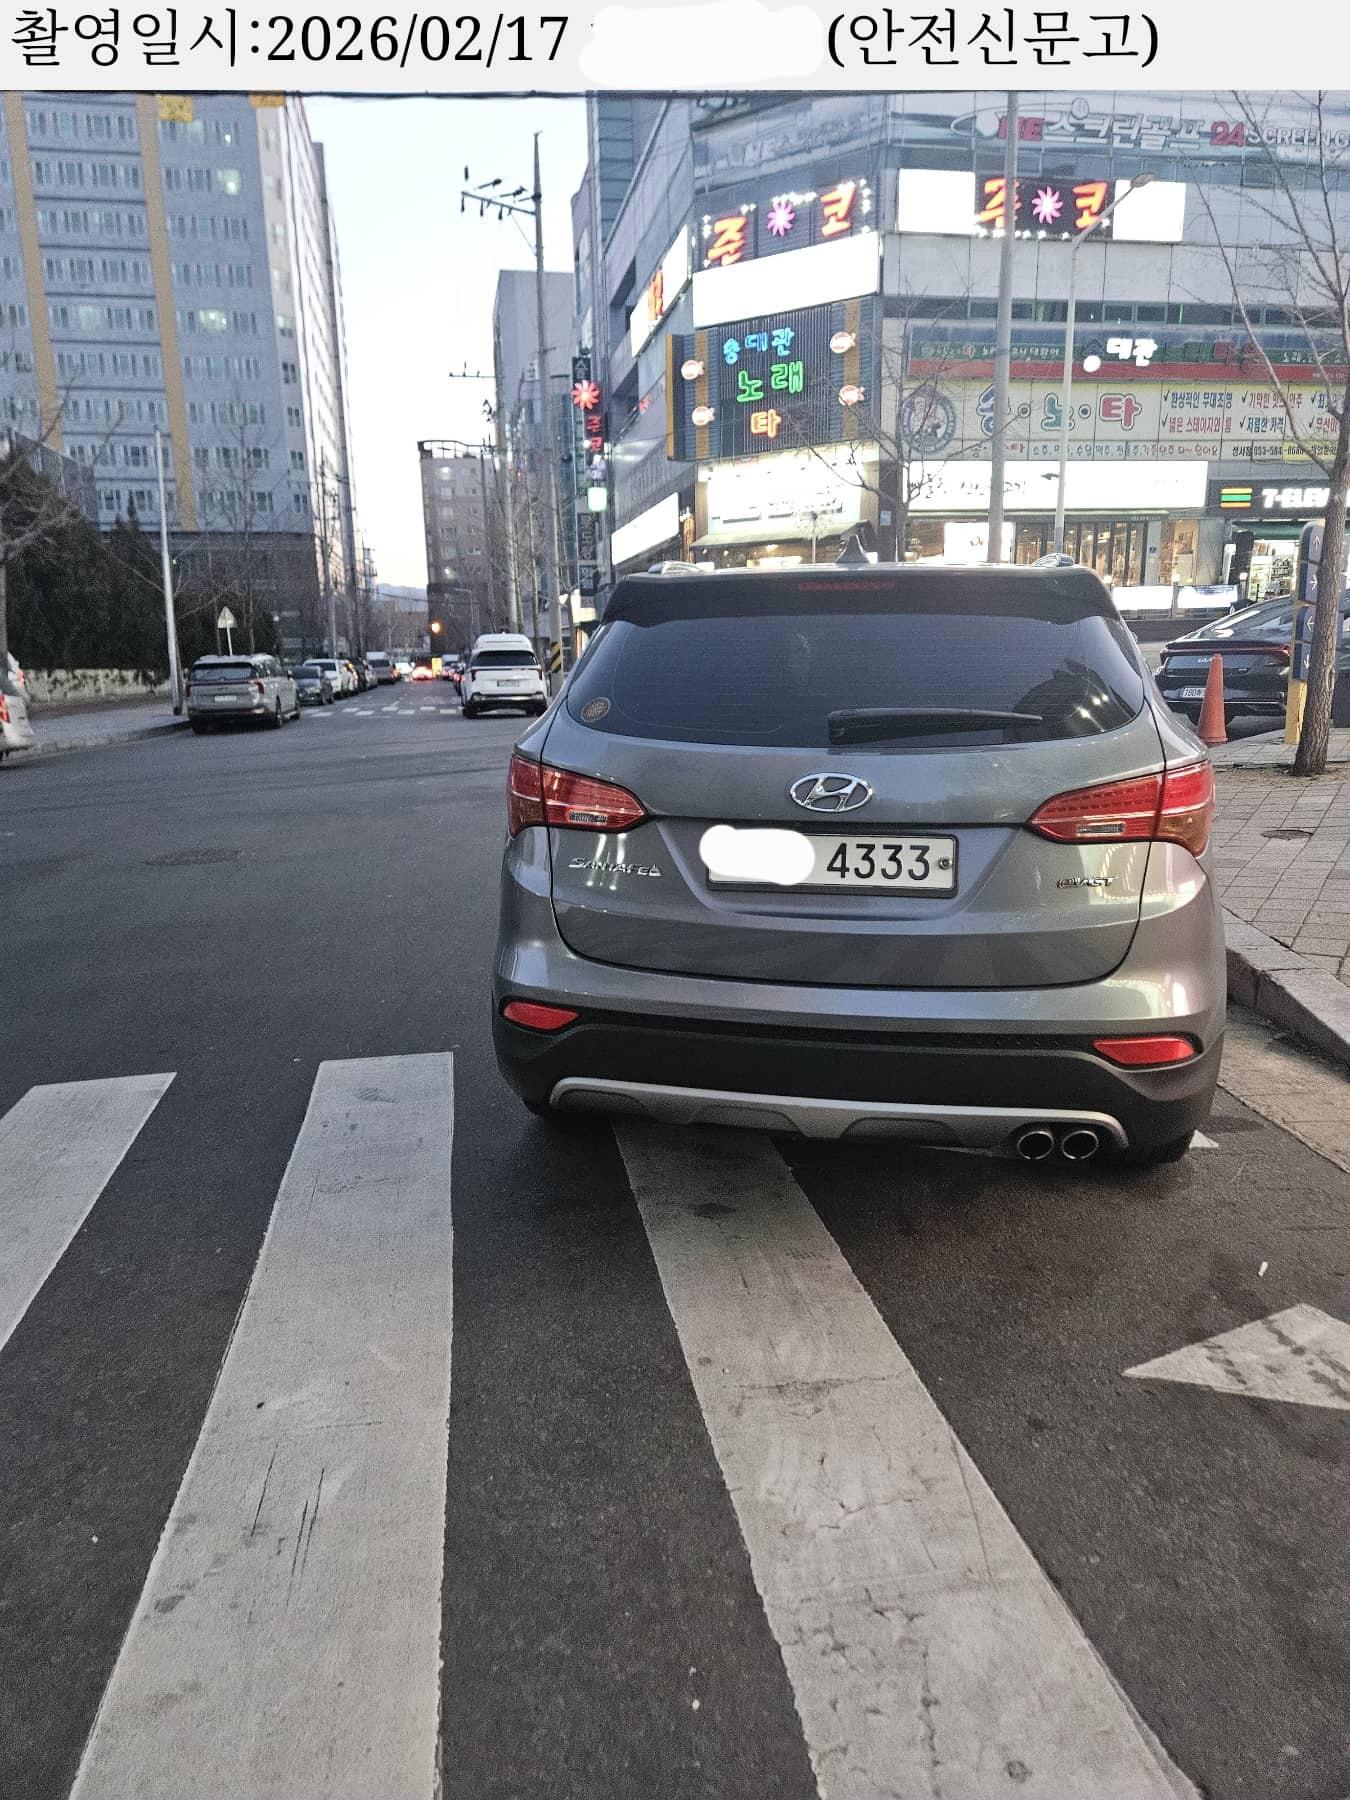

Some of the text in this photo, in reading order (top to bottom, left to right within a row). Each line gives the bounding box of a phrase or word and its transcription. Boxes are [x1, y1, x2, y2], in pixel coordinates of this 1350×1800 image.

[723, 327, 795, 365] 송대관
[736, 360, 804, 402] 노래
[751, 408, 782, 438] 타
[1247, 416, 1268, 433] 저렴한
[1261, 487, 1350, 509] 7-ELEV
[827, 842, 931, 881] 4333
